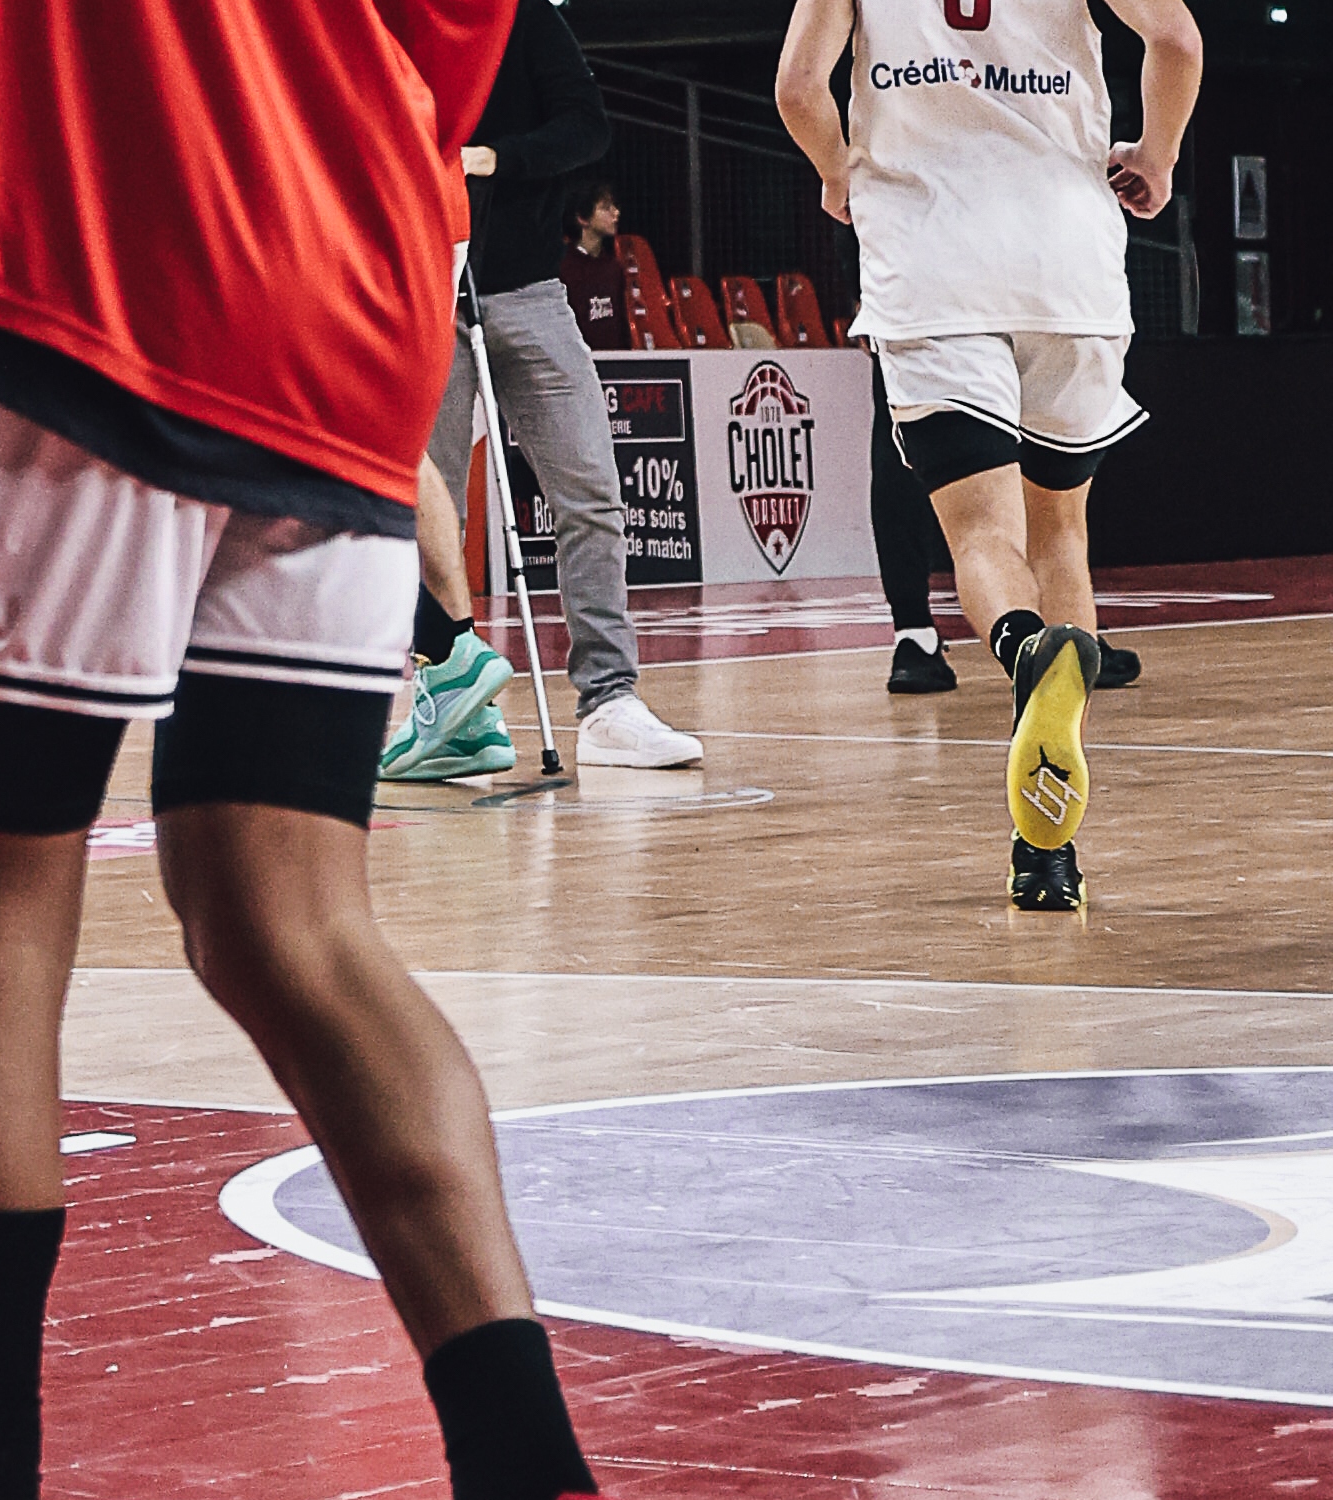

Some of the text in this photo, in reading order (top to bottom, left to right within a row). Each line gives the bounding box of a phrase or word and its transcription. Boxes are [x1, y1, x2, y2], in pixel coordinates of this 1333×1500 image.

[870, 57, 1071, 96] Crédit Mutuel
[611, 420, 632, 435] ERIE
[728, 419, 814, 494] CHOLET
[624, 455, 684, 502] -10%
[650, 508, 686, 530] soirs
[752, 496, 800, 526] BASKET
[647, 537, 692, 560] match
